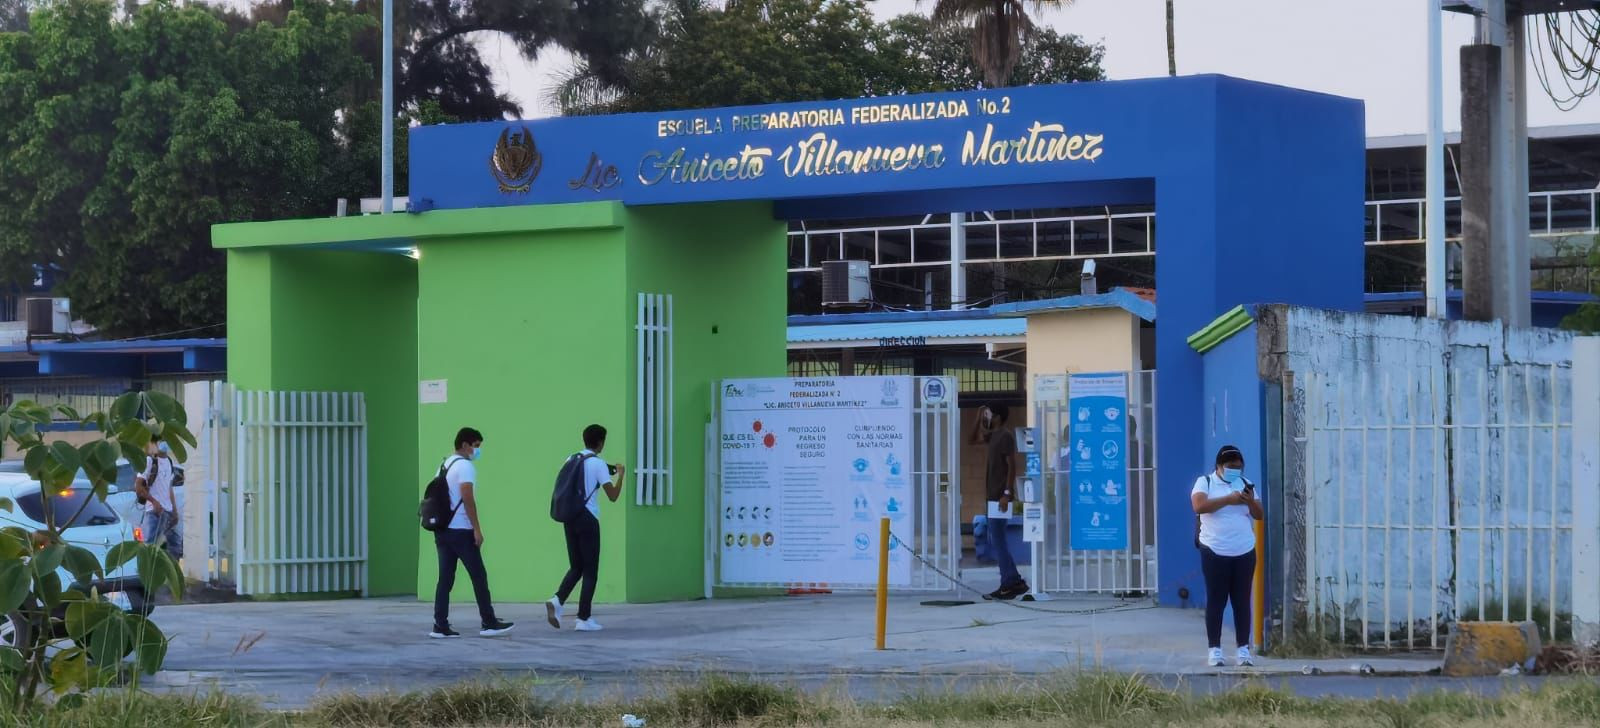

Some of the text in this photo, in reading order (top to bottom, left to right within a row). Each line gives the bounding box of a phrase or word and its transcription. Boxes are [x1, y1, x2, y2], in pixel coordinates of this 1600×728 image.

[658, 116, 723, 137] ESCUELA
[732, 110, 845, 133] PREPARATORIA
[851, 99, 969, 125] FEDERALIZADA
[568, 151, 624, 193] Lic.
[638, 144, 773, 186] Aniceto
[776, 132, 946, 175] Villanueva
[794, 380, 835, 388] PREPARATORIA
[789, 390, 828, 398] FEDERALIZADA
[777, 401, 801, 409] ANICETO
[802, 401, 835, 409] VILLANUEVA
[788, 425, 826, 433] PROTOCOLO
